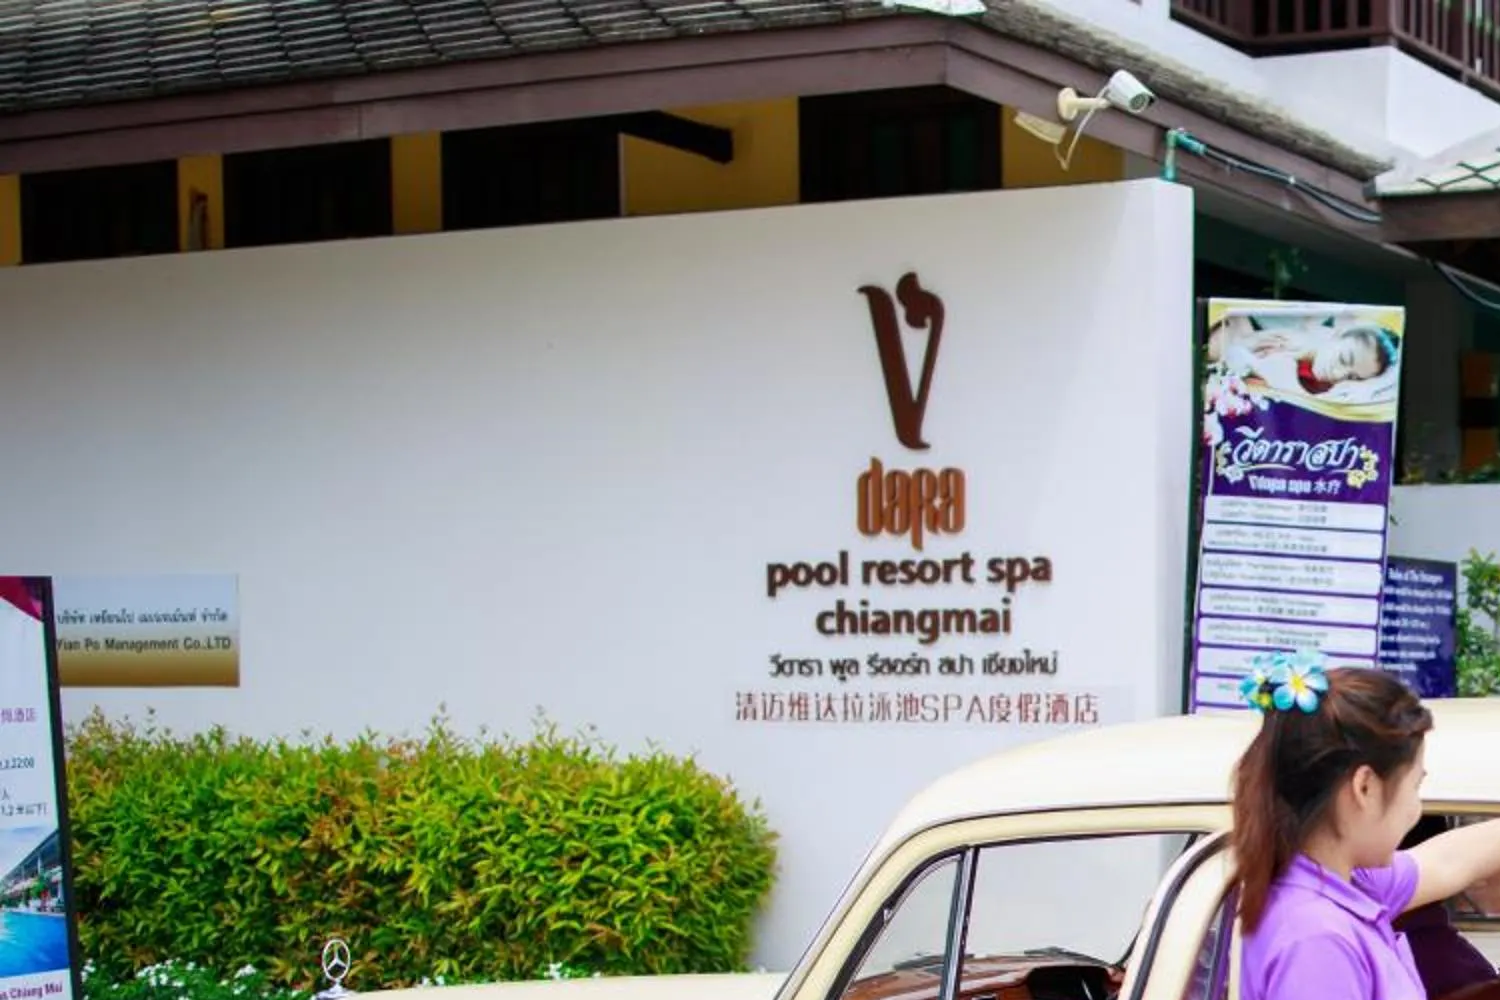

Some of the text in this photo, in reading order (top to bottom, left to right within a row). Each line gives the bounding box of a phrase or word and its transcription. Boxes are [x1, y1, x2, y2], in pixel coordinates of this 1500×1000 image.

[767, 551, 1052, 596] pool resort spa
[816, 599, 1012, 644] chiangmai
[105, 637, 179, 653] Management
